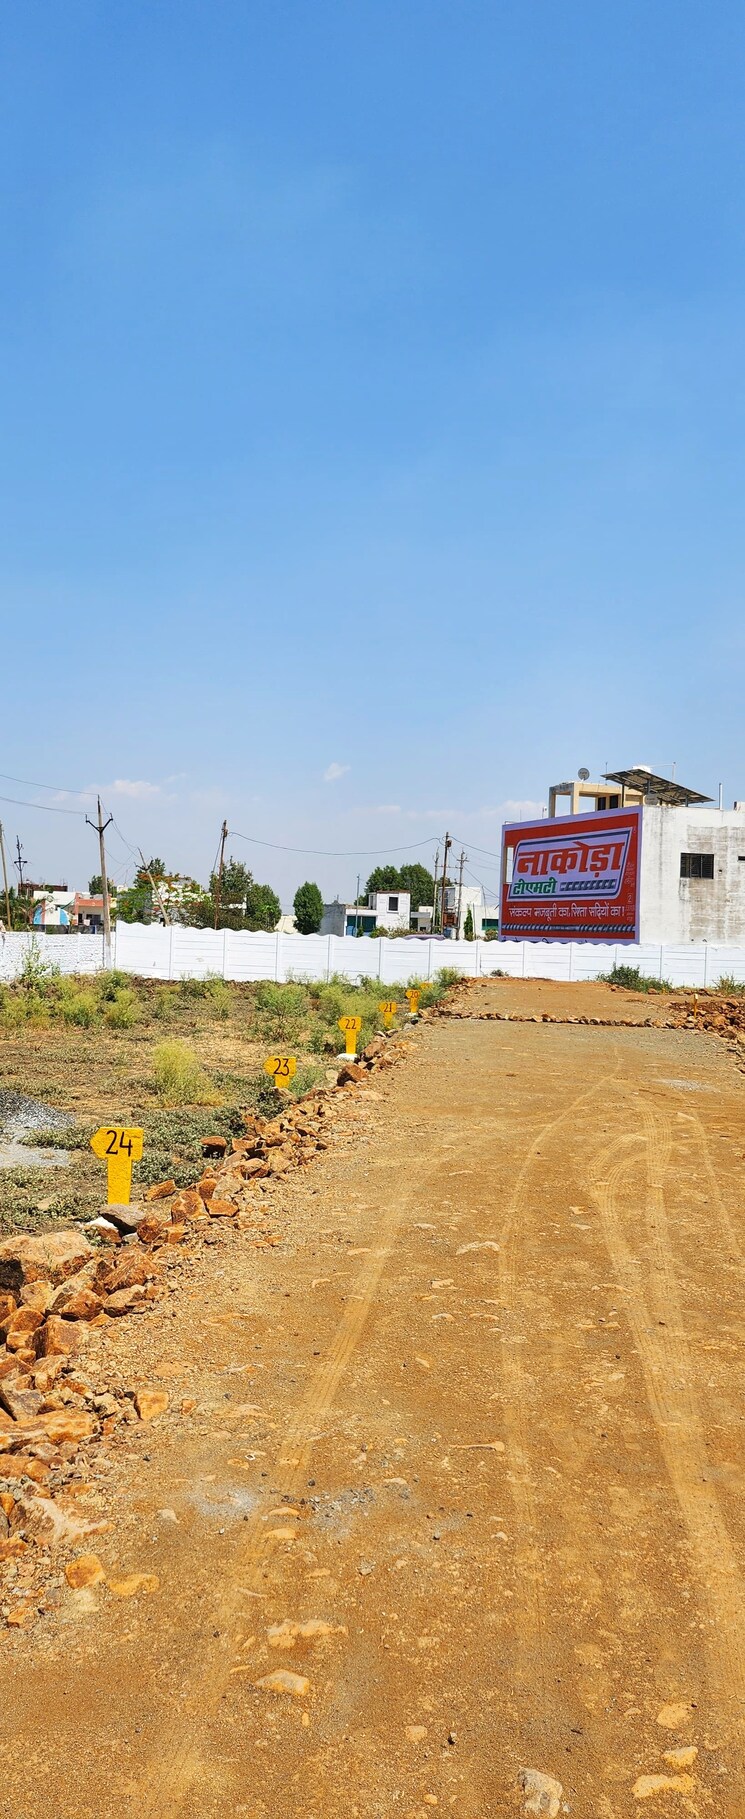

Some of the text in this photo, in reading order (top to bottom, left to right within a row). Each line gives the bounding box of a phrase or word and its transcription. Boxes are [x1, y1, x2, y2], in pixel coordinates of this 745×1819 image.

[517, 841, 626, 878] नाकोड़ा
[512, 876, 558, 895] टीएमटी
[534, 903, 557, 921] मजबूती
[588, 901, 609, 919] सदियों
[384, 1003, 392, 1012] 21
[345, 1018, 357, 1030] 22
[273, 1058, 290, 1076] 23
[105, 1130, 133, 1157] 24
